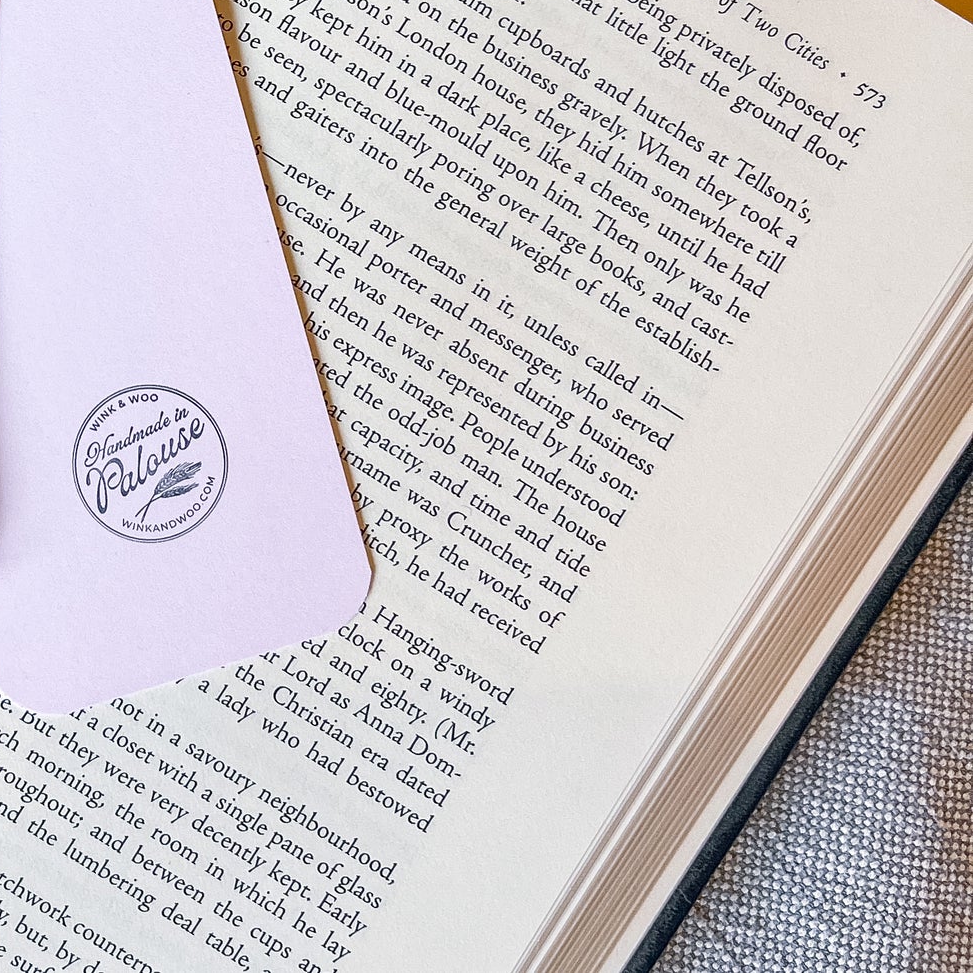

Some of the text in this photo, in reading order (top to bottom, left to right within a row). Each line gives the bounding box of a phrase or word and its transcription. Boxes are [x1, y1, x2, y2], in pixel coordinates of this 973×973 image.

[741, 2, 779, 37] Two
[785, 33, 830, 70] Cities
[853, 83, 886, 109] 573
[557, 93, 798, 248] gravely. When they took a
[434, 192, 720, 372] general weight of the establish-
[84, 407, 189, 467] Handmade in
[89, 393, 159, 432] WINK & WOO
[86, 417, 205, 514] Palouse
[121, 475, 216, 533] WINKANDWOO.COM
[14, 914, 48, 952] but,
[55, 940, 81, 970] by
